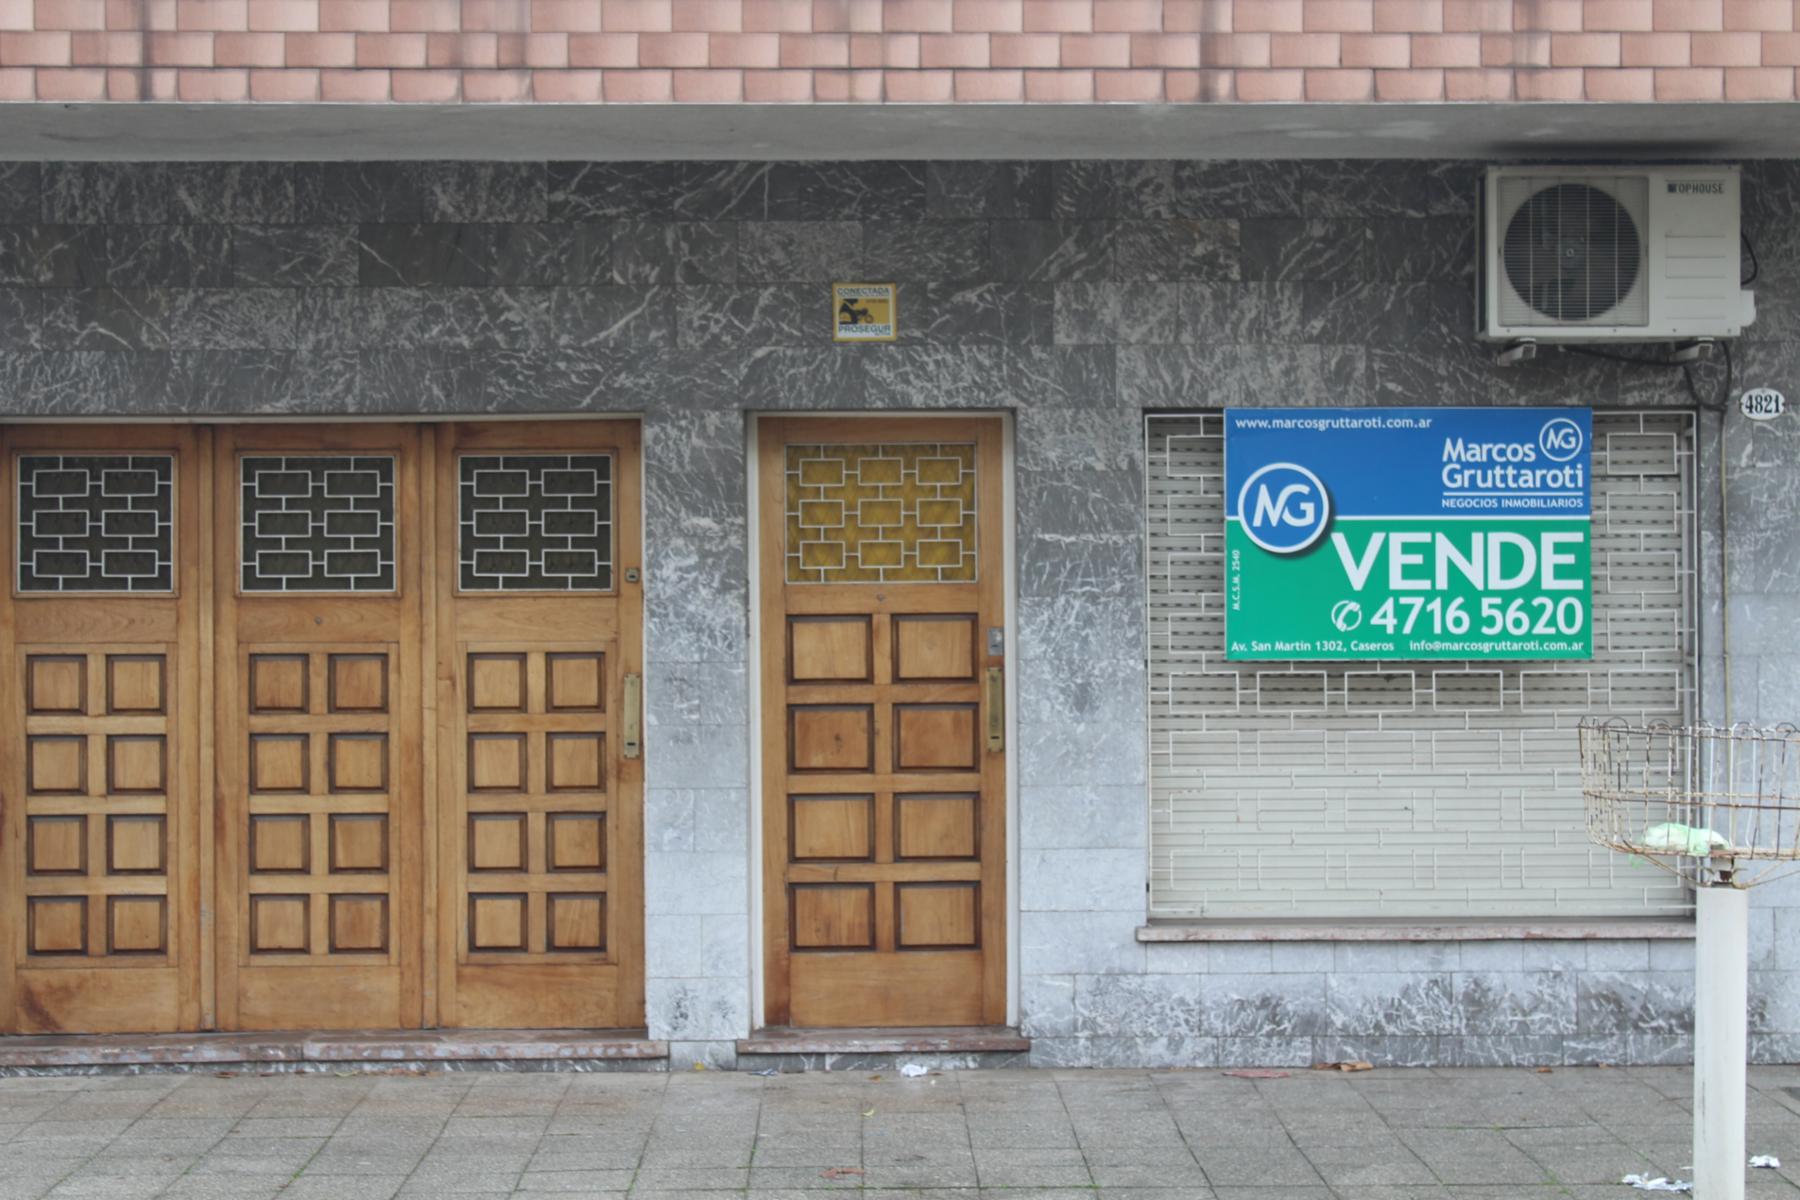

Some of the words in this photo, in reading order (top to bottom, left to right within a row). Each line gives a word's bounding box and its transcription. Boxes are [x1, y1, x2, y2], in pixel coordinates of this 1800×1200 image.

[837, 287, 890, 295] CONECTADA
[839, 324, 892, 333] PROSEGUR
[1745, 394, 1780, 414] 4821
[1235, 416, 1432, 431] www.marcosgruttaroti.com.ar
[1442, 437, 1536, 462] Marcos
[1441, 463, 1584, 488] Gruttaroti
[1441, 498, 1498, 508] NEGOCIOS
[1501, 498, 1584, 508] INMOBILIARIOS
[1331, 532, 1584, 591] VENDE
[1370, 596, 1471, 635] 4716
[1480, 596, 1584, 635] 5620
[1231, 641, 1248, 652] Av.
[1251, 641, 1272, 652] San
[1315, 640, 1347, 654] 1302,
[1350, 640, 1395, 652] Caseros
